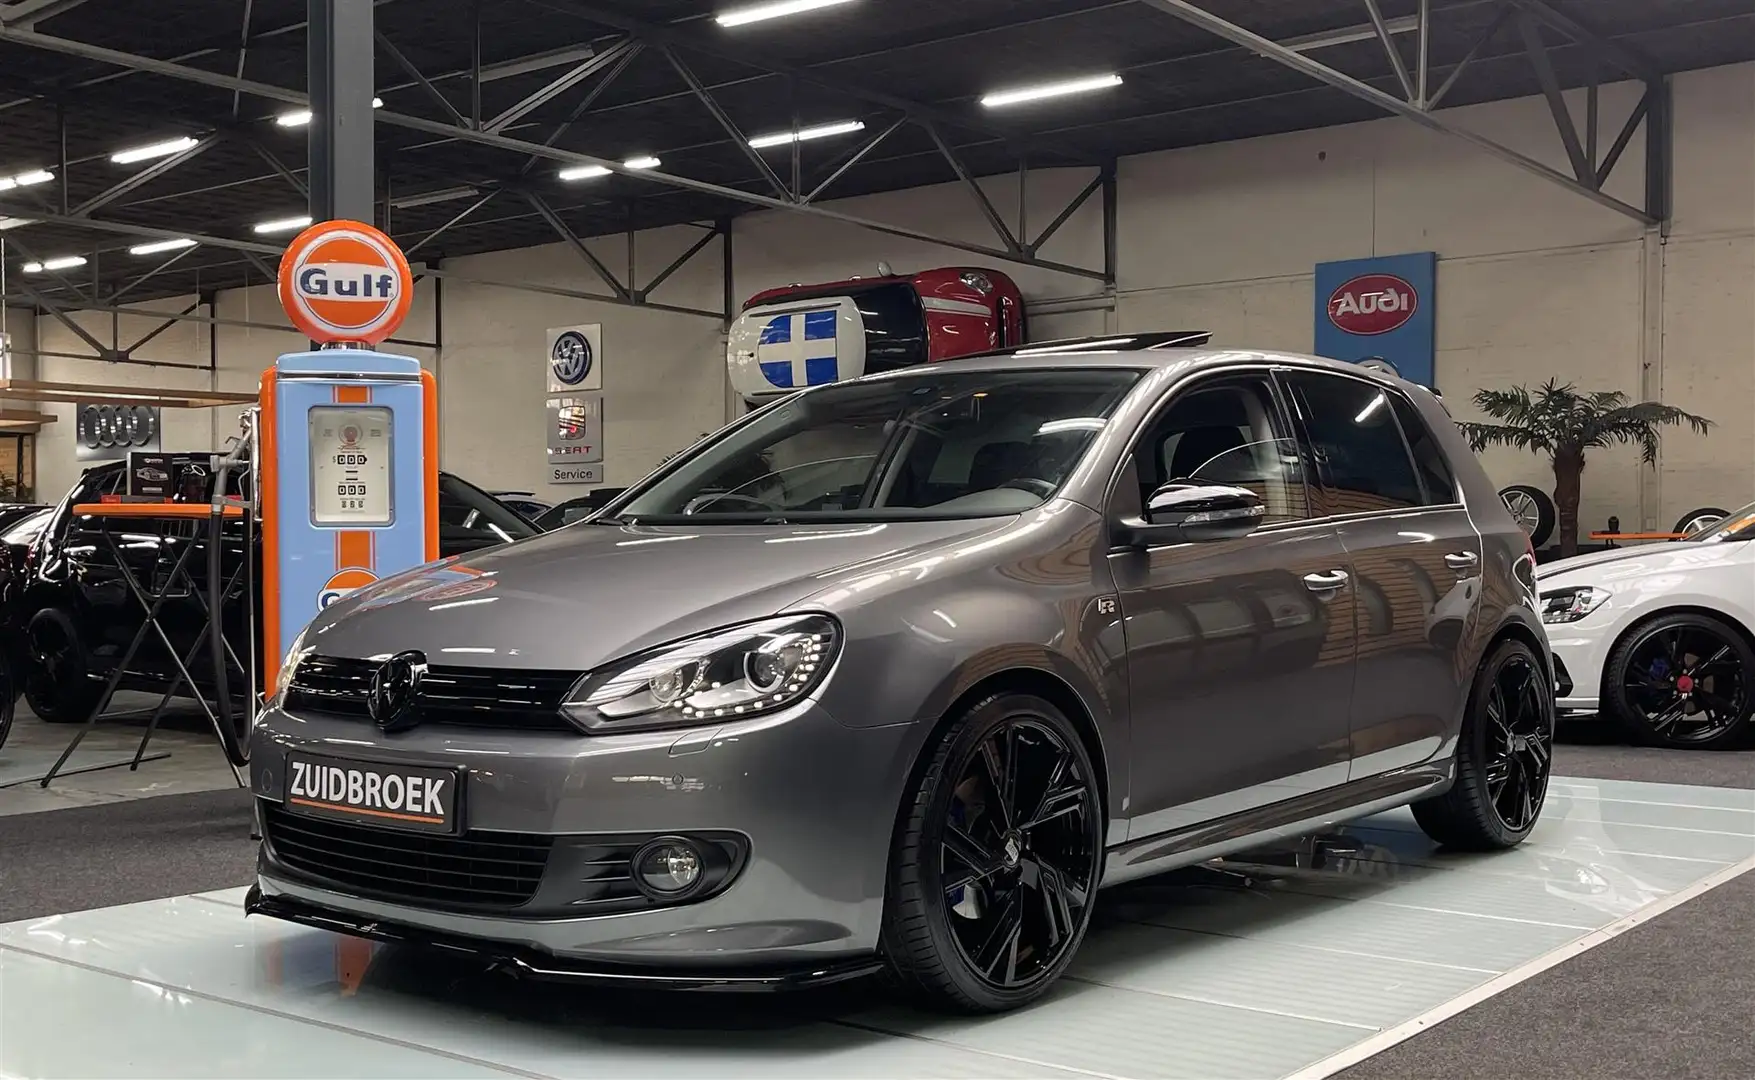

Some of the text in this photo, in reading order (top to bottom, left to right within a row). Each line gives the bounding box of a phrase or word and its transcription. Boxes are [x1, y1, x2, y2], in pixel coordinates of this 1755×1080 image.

[300, 267, 392, 298] Gulf
[554, 445, 593, 456] SEAT
[554, 469, 593, 480] Service
[290, 762, 445, 815] ZUIDBROEK
